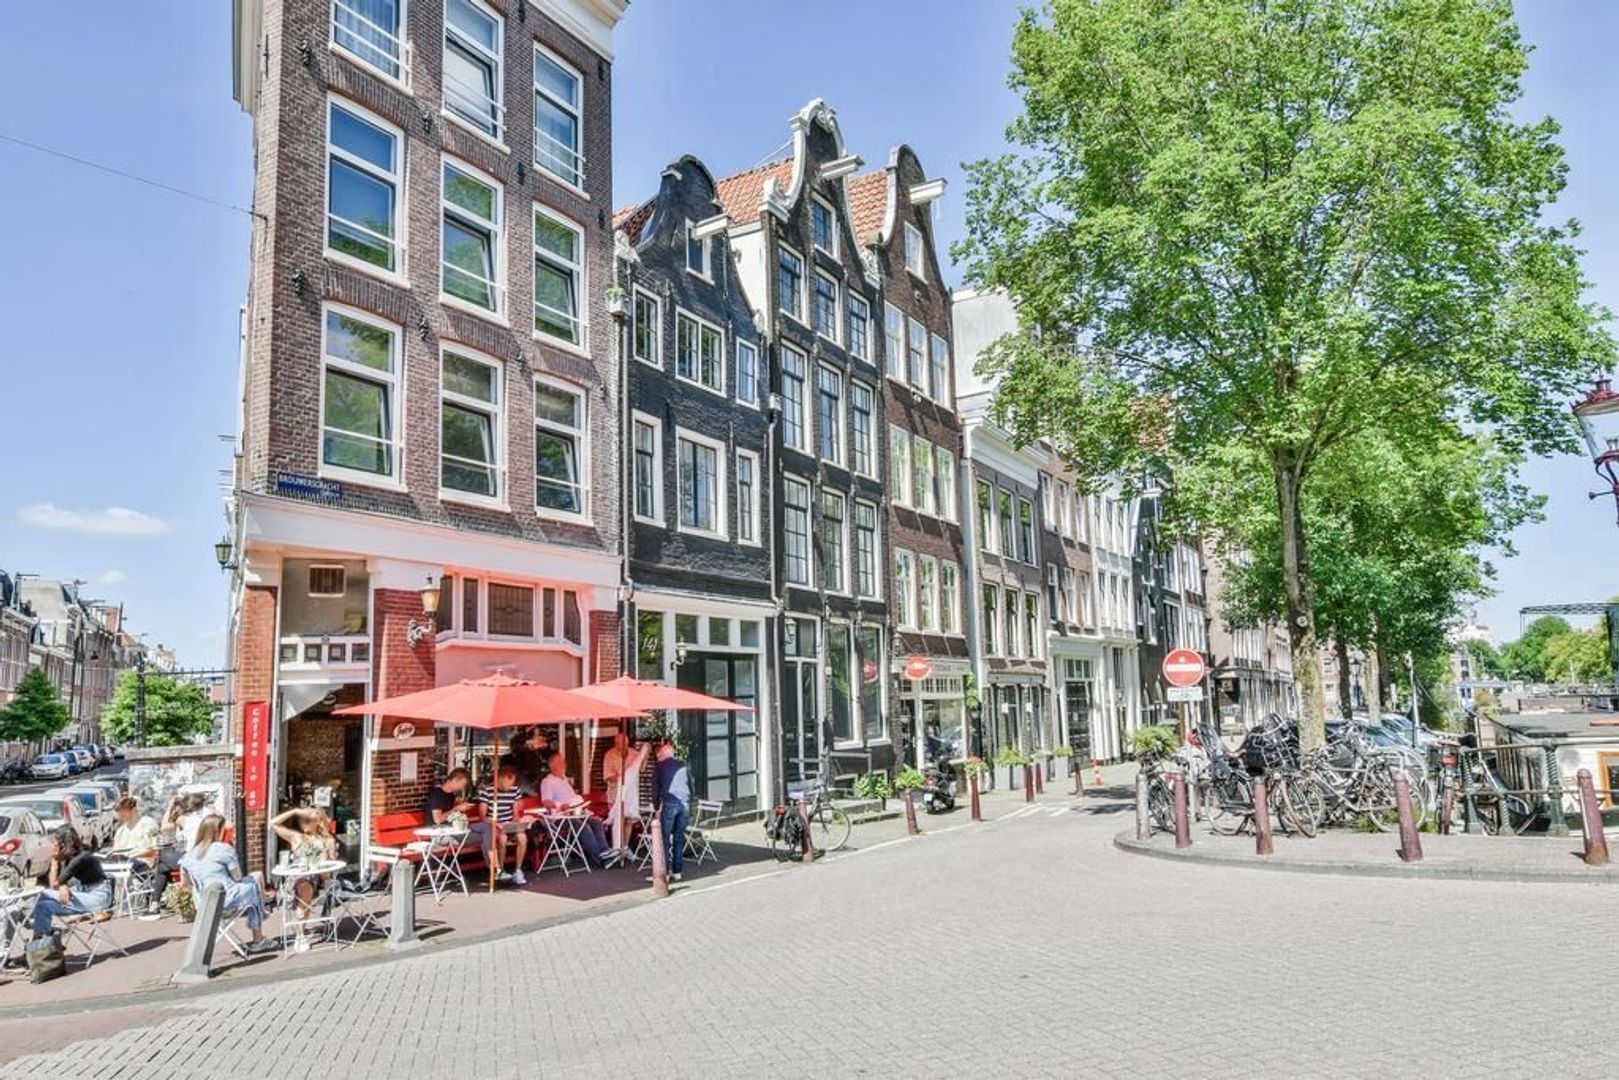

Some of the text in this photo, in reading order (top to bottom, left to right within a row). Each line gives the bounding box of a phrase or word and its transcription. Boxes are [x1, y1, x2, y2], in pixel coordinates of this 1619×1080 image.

[278, 474, 340, 491] BROUWERSGRACHT
[251, 707, 260, 756] Coffee
[249, 765, 257, 781] to
